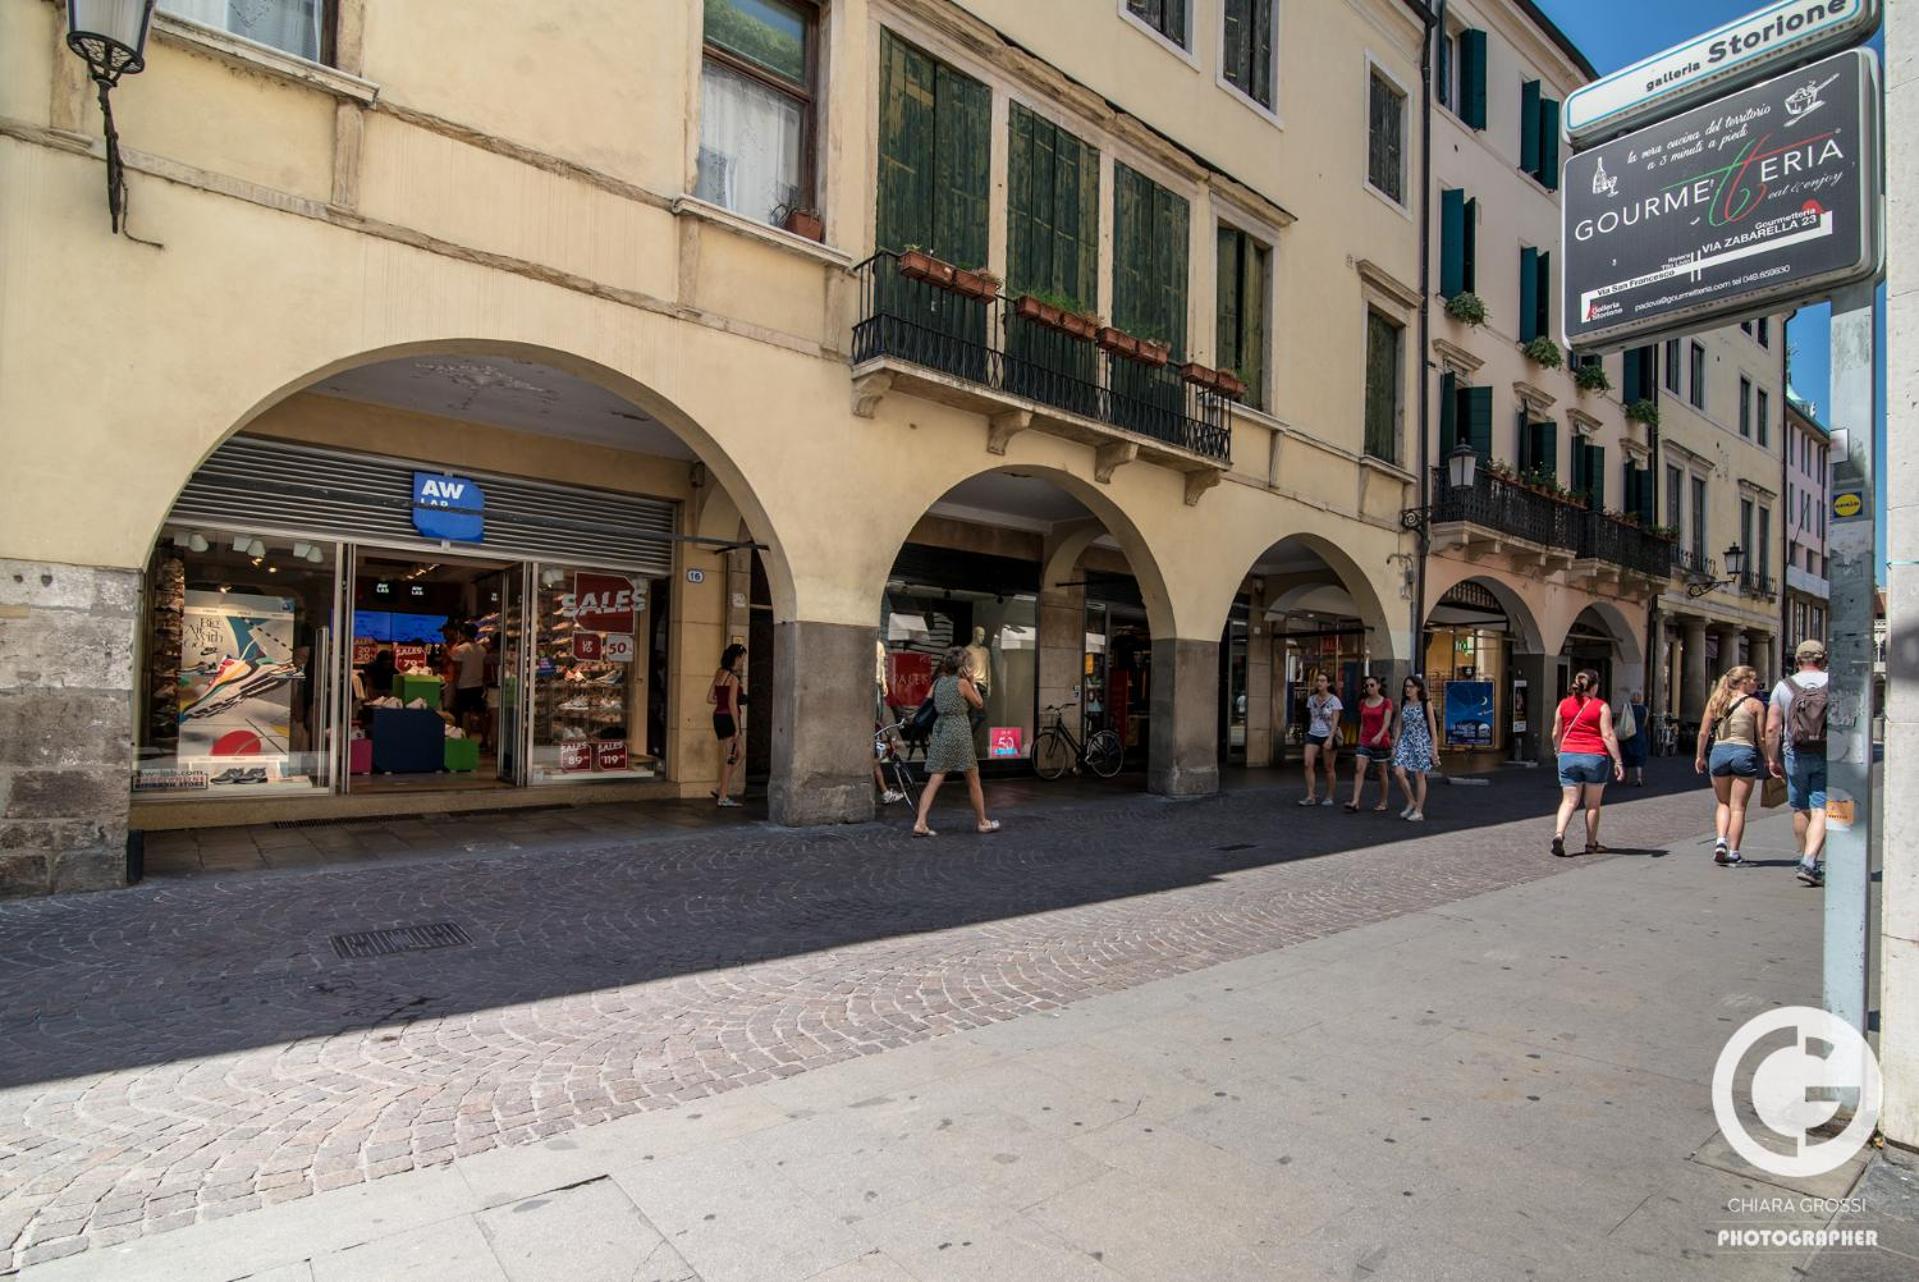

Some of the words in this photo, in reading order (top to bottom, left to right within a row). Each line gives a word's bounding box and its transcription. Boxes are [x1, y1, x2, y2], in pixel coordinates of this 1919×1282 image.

[1646, 62, 1701, 92] galleria
[1707, 0, 1846, 63] Storione
[1627, 150, 1638, 164] la
[1667, 131, 1701, 149] cucina
[1705, 117, 1723, 135] del
[1725, 103, 1771, 128] territorio
[1647, 162, 1656, 170] a
[1660, 155, 1667, 166] 3
[1670, 140, 1704, 162] minuti
[1708, 139, 1717, 149] a
[1717, 122, 1749, 151] piedi
[1768, 184, 1789, 200] eat
[1803, 172, 1843, 192] enjoy
[1755, 208, 1816, 230] Gourmetteria
[1702, 241, 1722, 253] VIA
[1724, 220, 1799, 248] ZABARELLA
[1801, 214, 1817, 227] 23
[1597, 287, 1610, 297] Via
[1611, 284, 1628, 293] San
[1629, 270, 1675, 287] Francesco
[421, 479, 465, 500] AW
[690, 572, 701, 581] 16
[561, 589, 646, 618] SALES
[561, 742, 587, 753] SALES
[598, 740, 624, 753] SALES
